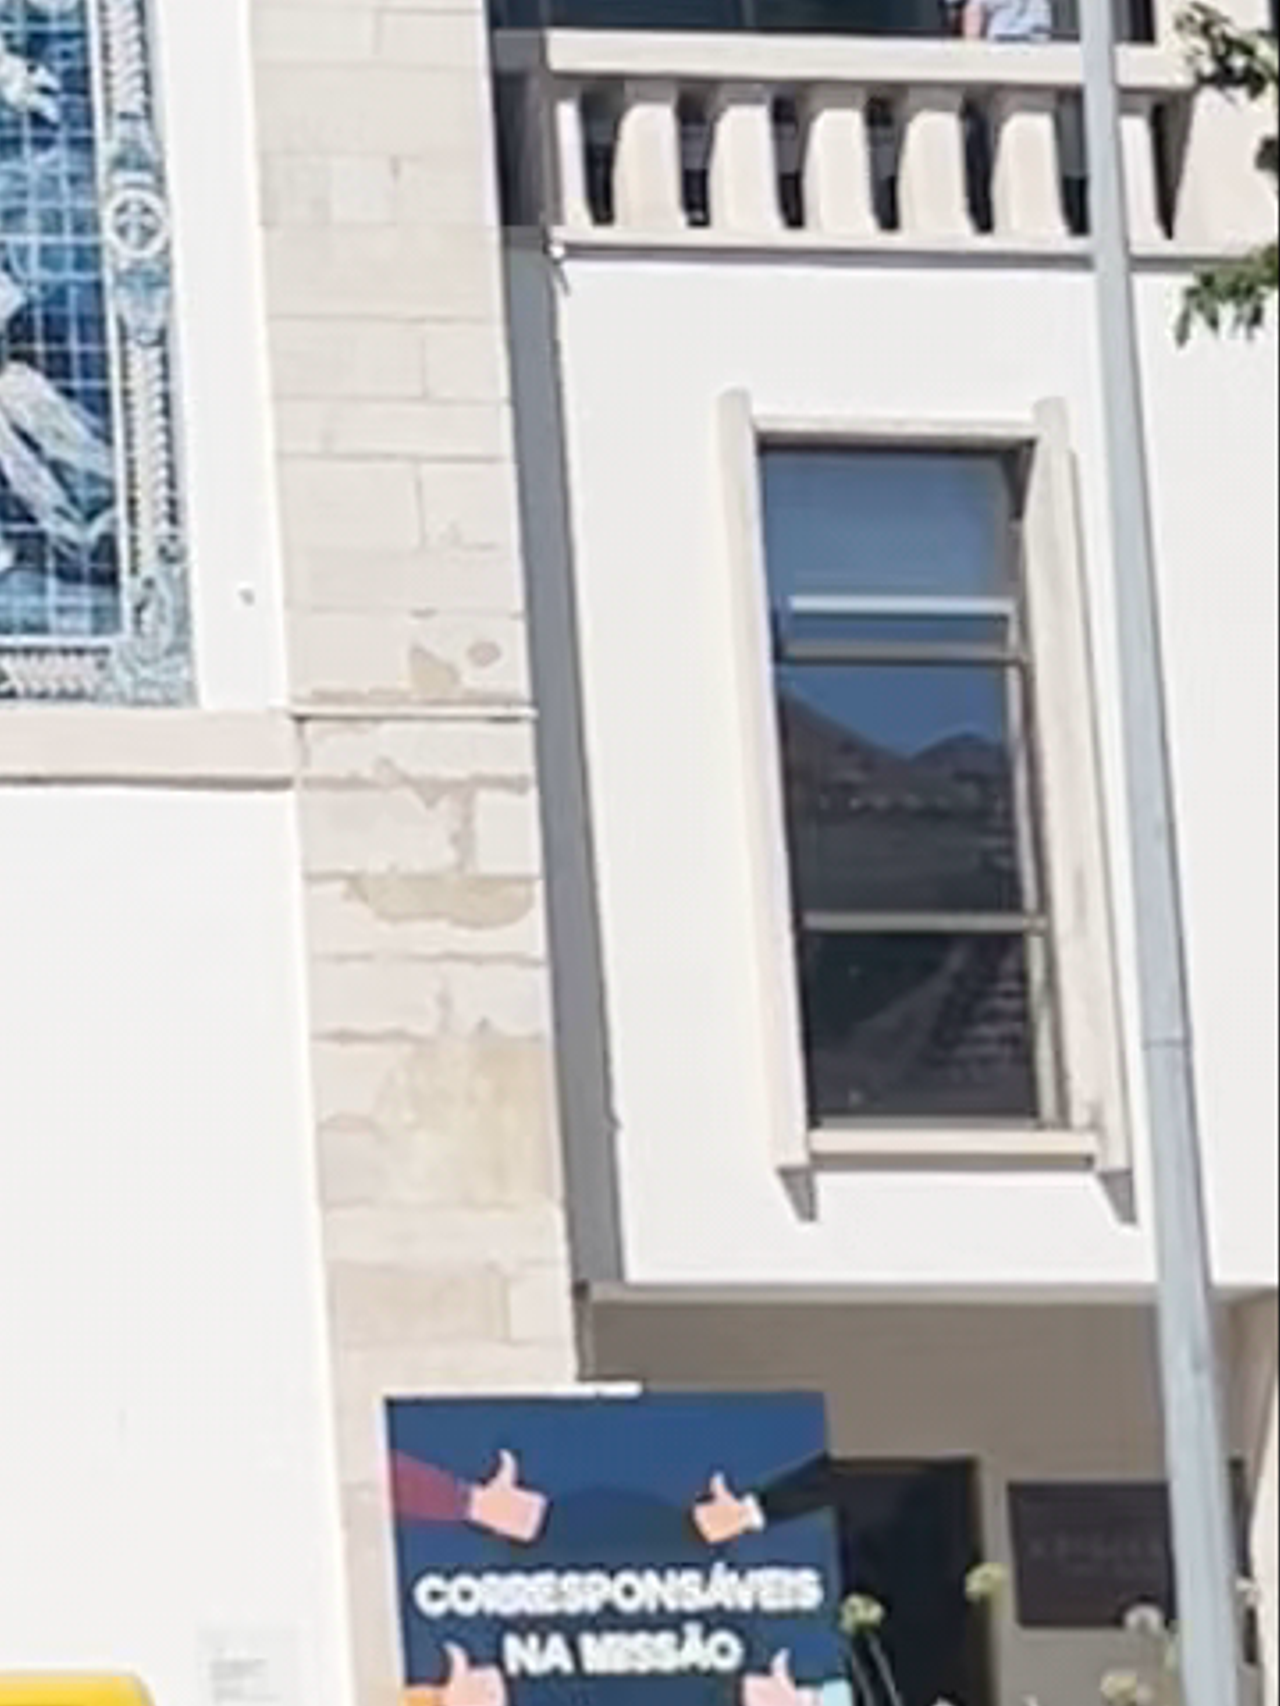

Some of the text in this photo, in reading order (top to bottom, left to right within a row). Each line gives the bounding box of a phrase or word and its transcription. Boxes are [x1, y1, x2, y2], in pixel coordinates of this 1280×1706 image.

[413, 1561, 824, 1618] CORRESPONSÁVEIS
[502, 1620, 743, 1676] NA MISSÃO
